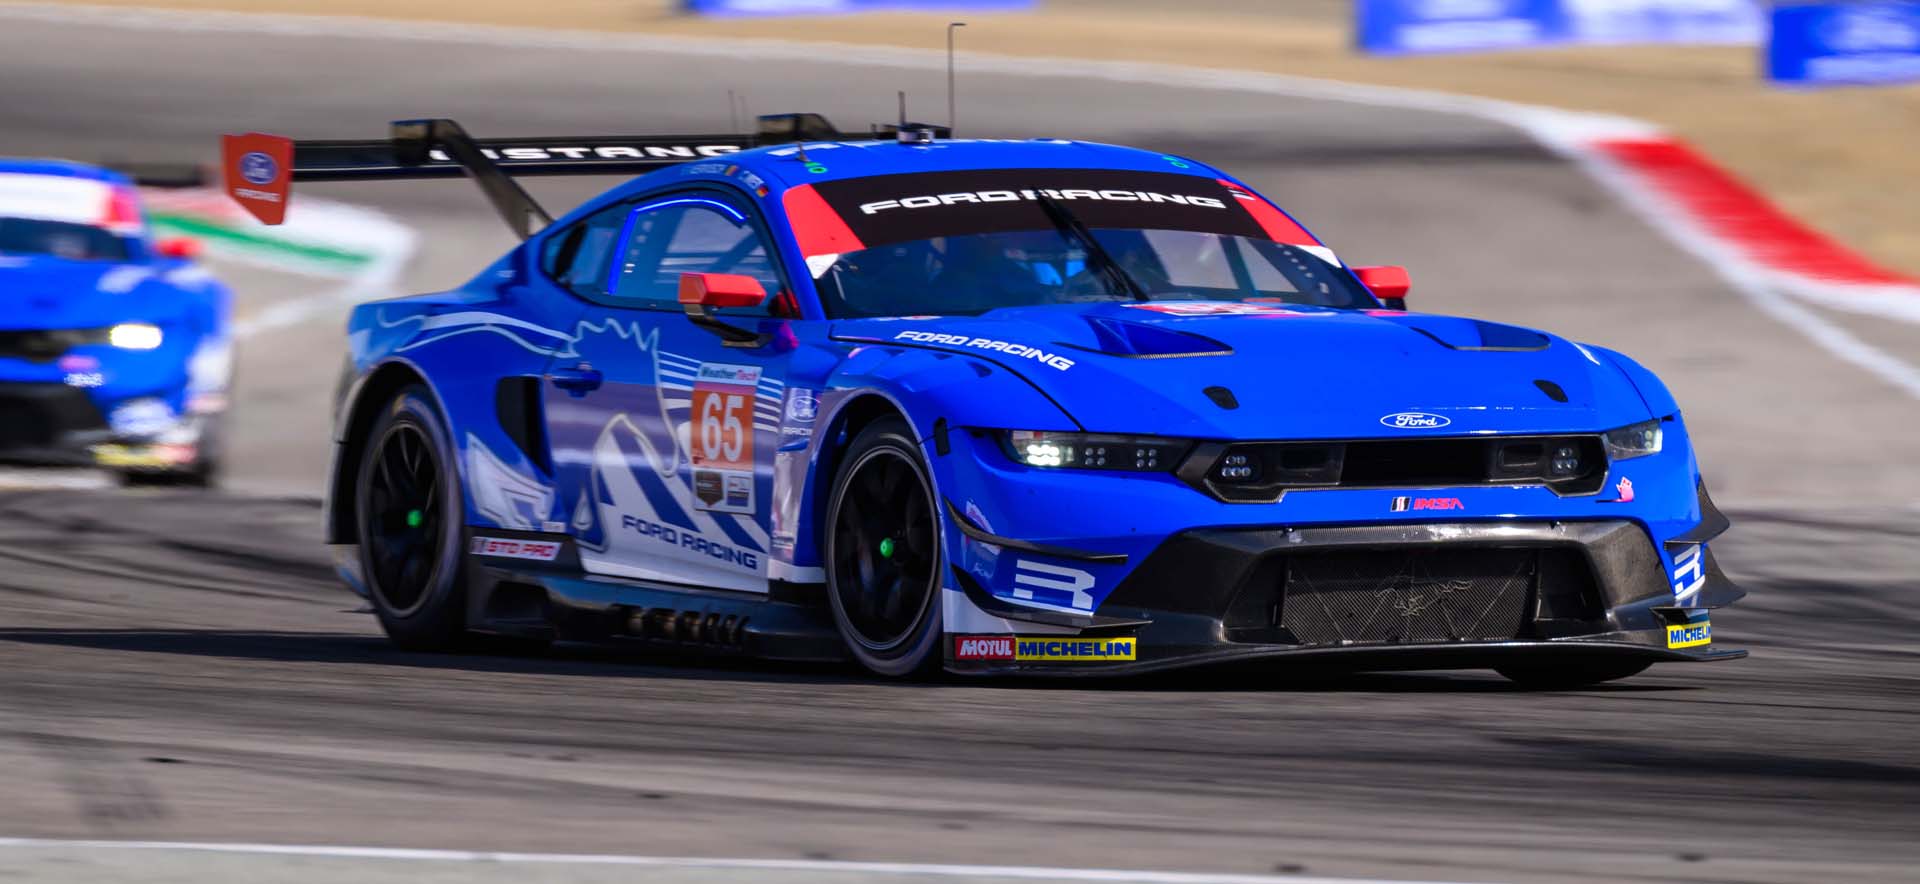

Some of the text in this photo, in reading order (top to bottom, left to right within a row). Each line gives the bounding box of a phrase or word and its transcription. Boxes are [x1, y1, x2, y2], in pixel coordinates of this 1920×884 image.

[430, 145, 741, 160] STANG
[859, 188, 1226, 214] FORD RACING
[895, 331, 1075, 371] FORD RACING
[701, 392, 745, 462] 65
[1395, 414, 1437, 426] Ford
[1413, 497, 1465, 510] IMSA
[622, 515, 677, 544] FORD
[681, 532, 757, 570] RACING
[960, 640, 1012, 656] MOTUL
[1018, 642, 1131, 657] MICHELIN
